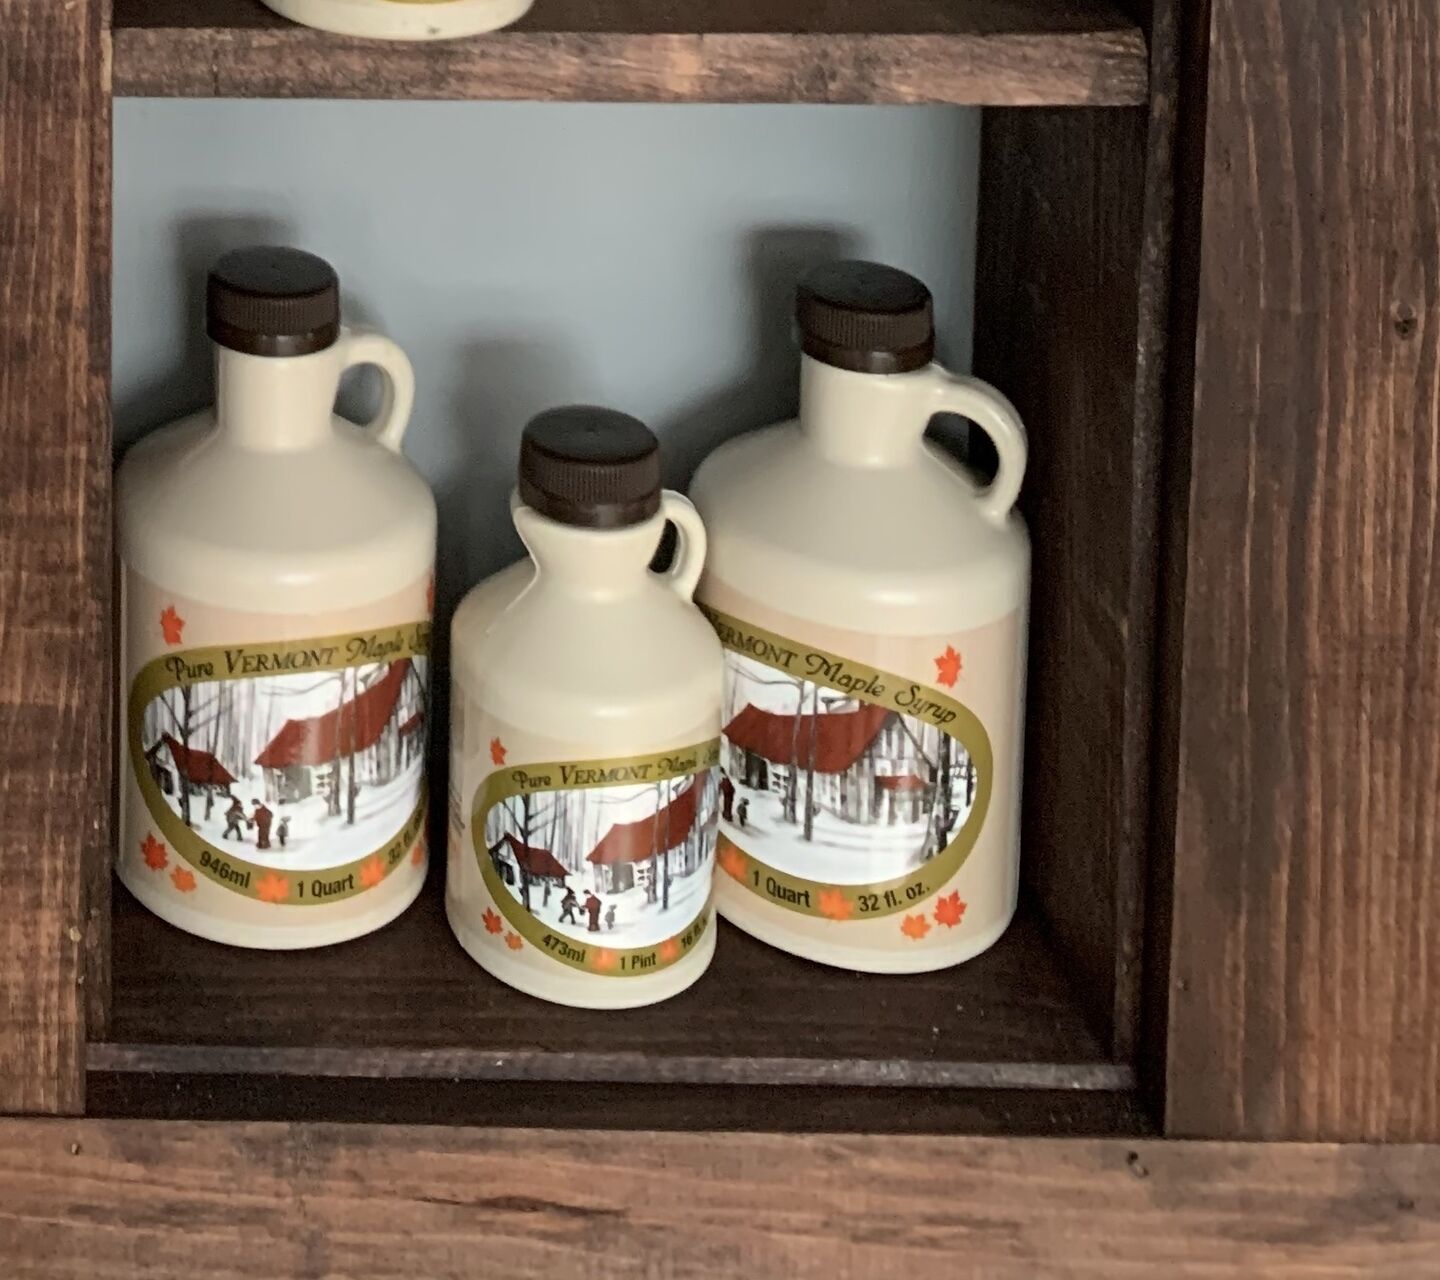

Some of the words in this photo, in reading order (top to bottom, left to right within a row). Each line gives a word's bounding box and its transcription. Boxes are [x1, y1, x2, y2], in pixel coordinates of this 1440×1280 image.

[164, 655, 215, 682] Pure
[224, 647, 339, 676] VERMONT
[804, 651, 887, 699] Maple
[893, 681, 959, 729] Syrup
[512, 768, 552, 791] Pure
[560, 763, 653, 786] VERMONT
[200, 849, 251, 889] 946ml
[297, 881, 304, 899] 1
[311, 873, 355, 899] Quart
[753, 870, 761, 888] 1
[766, 876, 811, 909] Quart
[858, 893, 881, 914] 32
[883, 890, 903, 907] fl.
[906, 882, 931, 901] oz.
[542, 932, 587, 966] 473ml
[620, 956, 626, 972] 1
[632, 951, 657, 971] Pint
